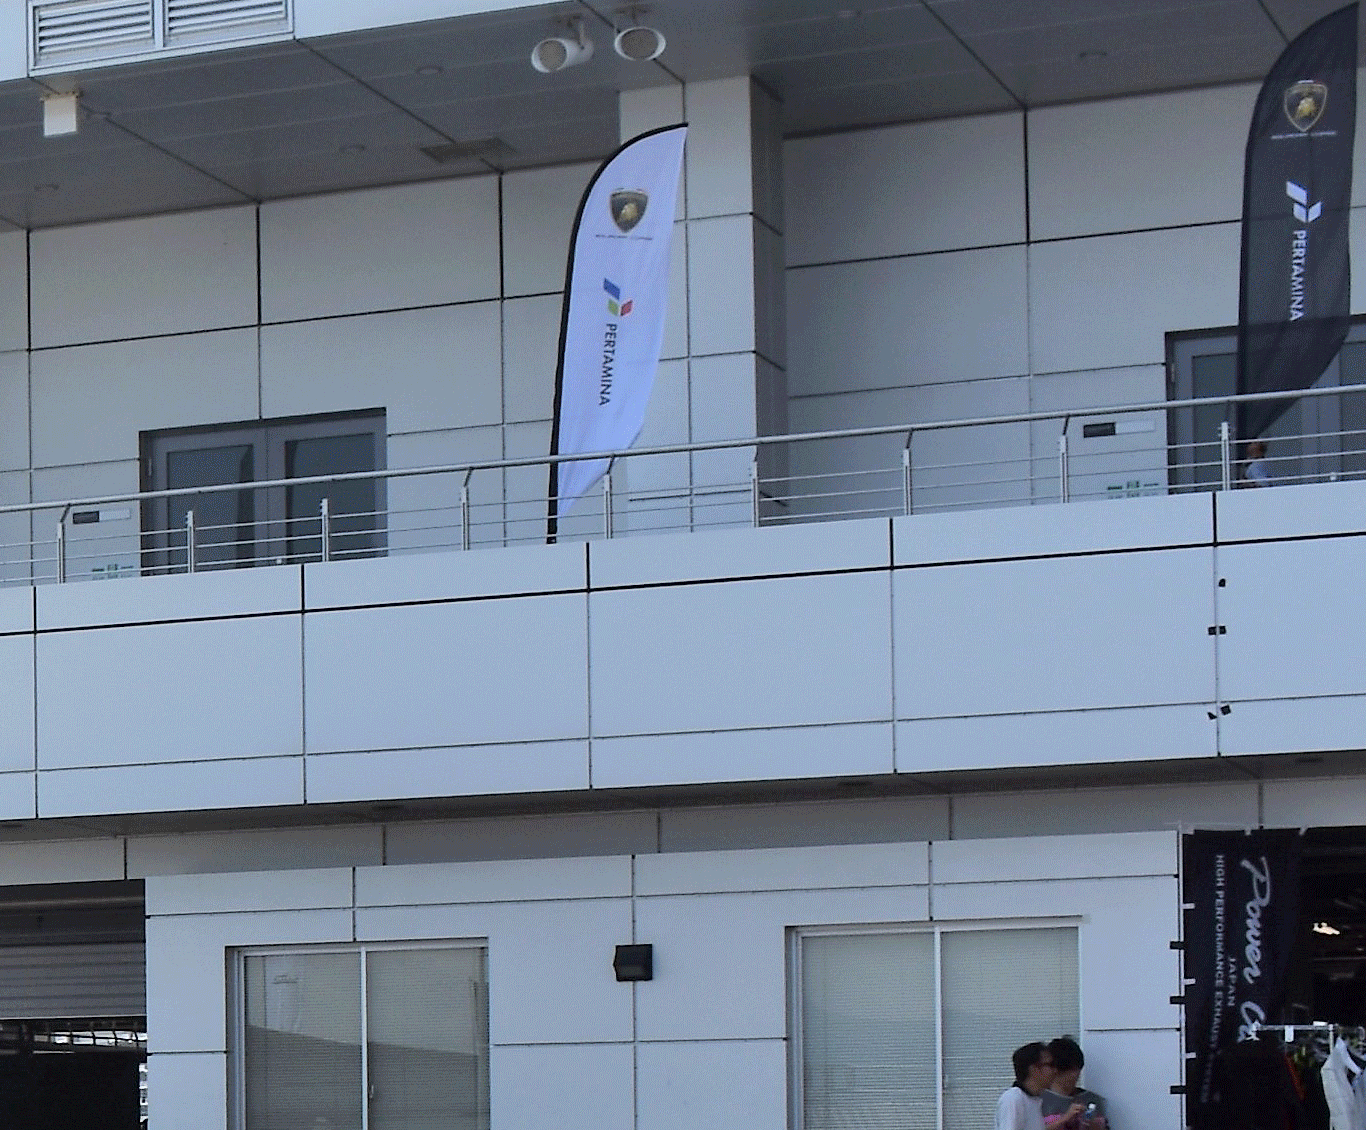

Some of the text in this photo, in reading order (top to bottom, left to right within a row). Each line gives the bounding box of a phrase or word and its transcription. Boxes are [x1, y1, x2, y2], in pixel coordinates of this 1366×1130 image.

[1289, 229, 1307, 322] PERTAMINA
[599, 323, 618, 406] PERTAMINA
[1215, 854, 1225, 887] HIGH
[1214, 890, 1225, 987] PERFORMANCE
[1226, 956, 1237, 1007] JAPAN
[1209, 991, 1224, 1049] EXHAUST
